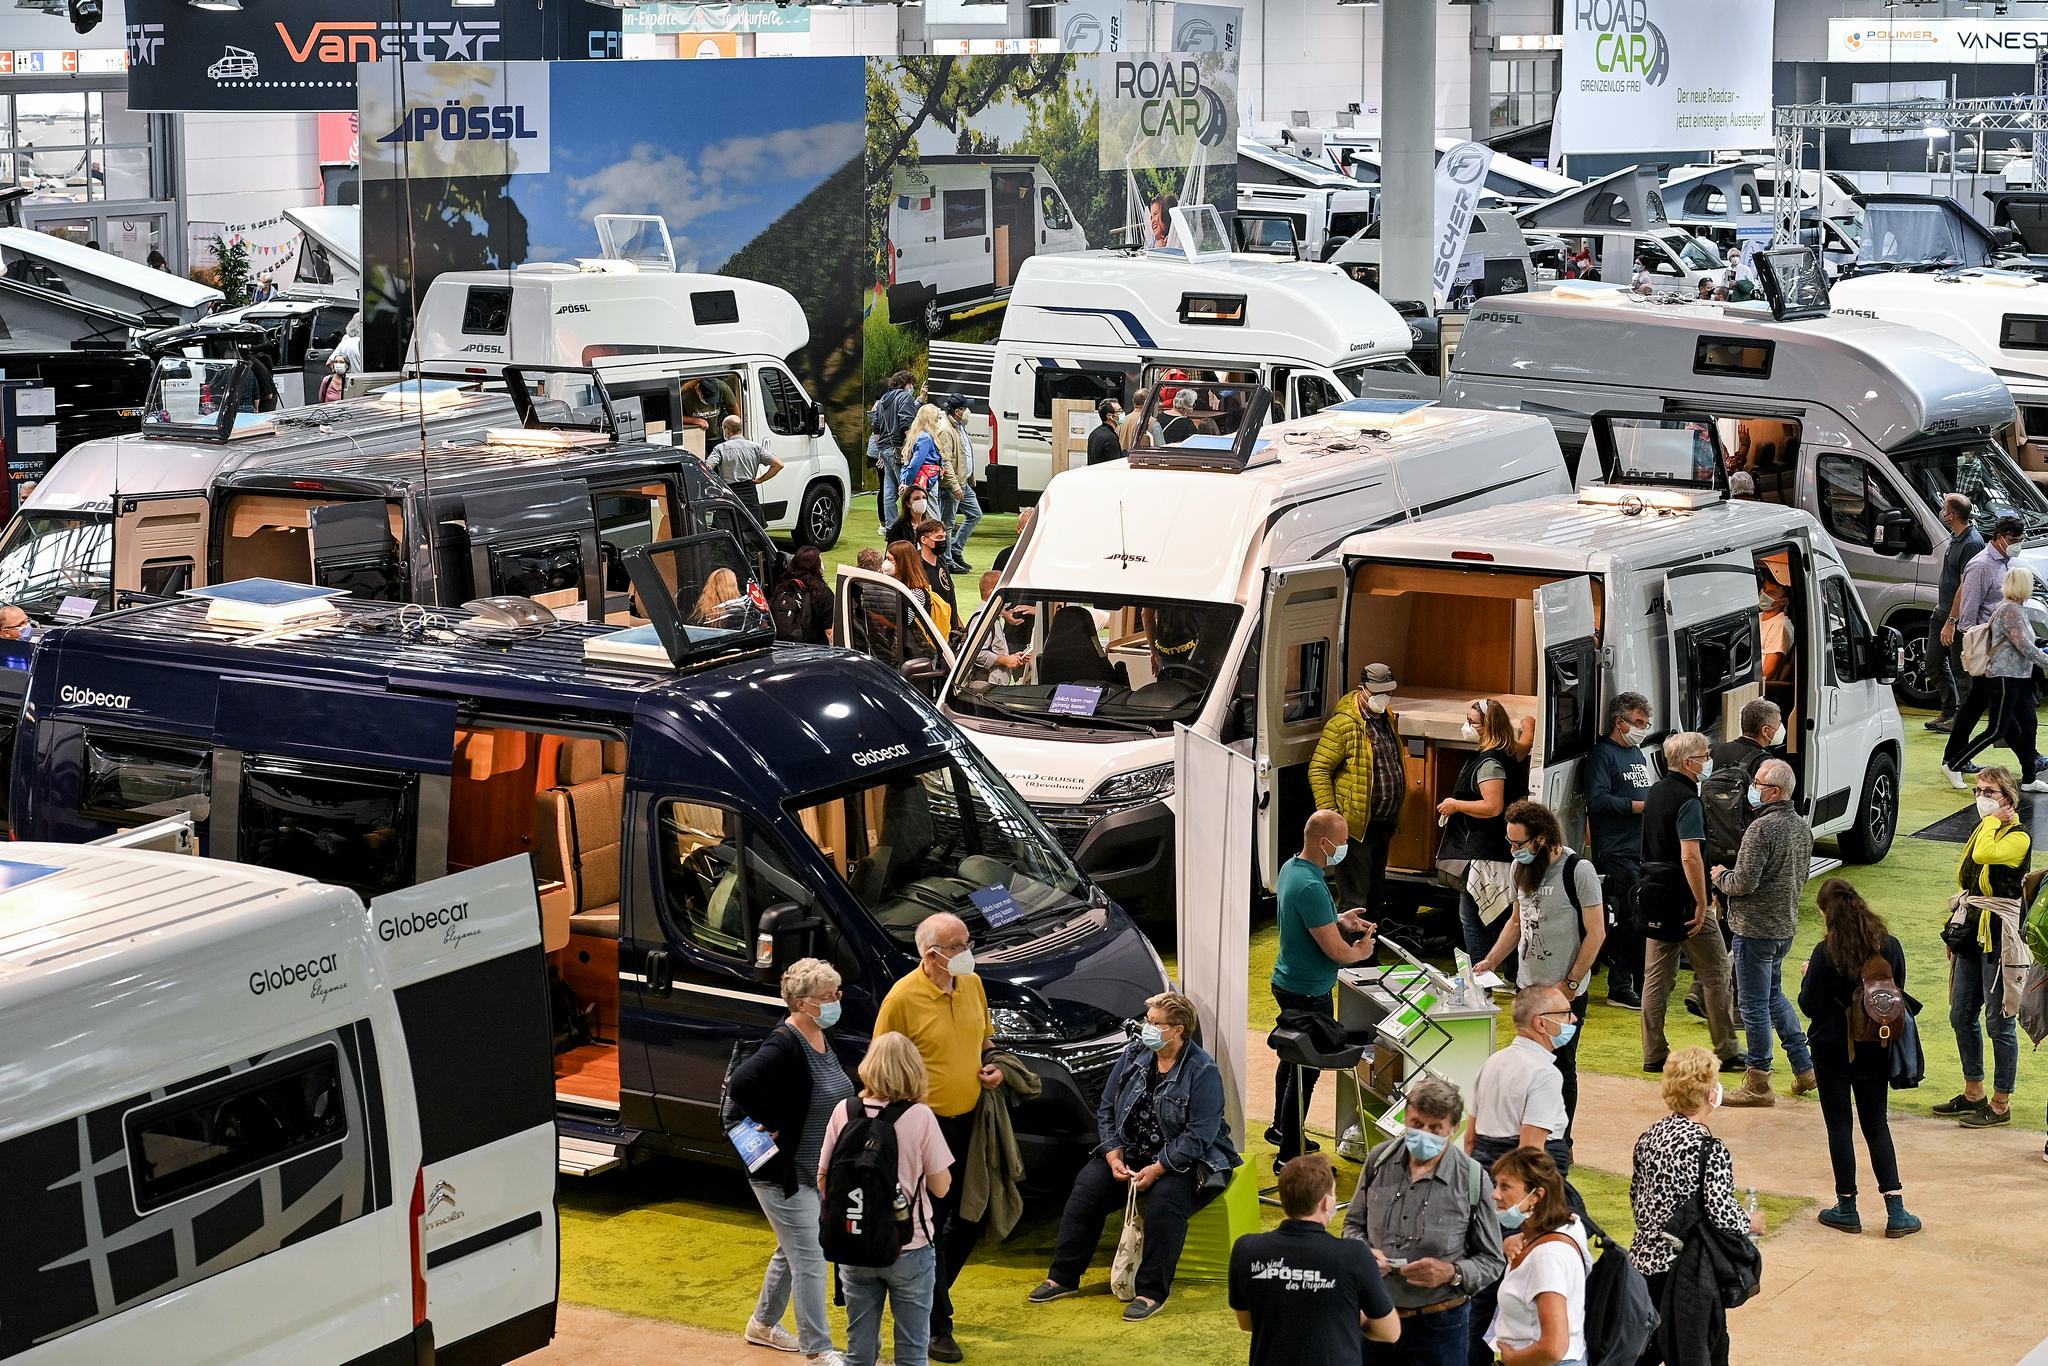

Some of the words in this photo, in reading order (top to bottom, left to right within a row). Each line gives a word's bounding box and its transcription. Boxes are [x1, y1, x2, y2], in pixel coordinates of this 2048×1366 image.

[1575, 0, 1648, 33] ROAD
[1866, 30, 1932, 39] POLIMER
[588, 30, 622, 58] CA
[1595, 33, 1652, 76] CAR
[1115, 61, 1200, 99] ROAD
[1580, 80, 1625, 92] GRENZENLOS
[1626, 81, 1641, 92] FREI
[1677, 87, 1689, 103] Der
[1690, 91, 1707, 103] neue
[1708, 87, 1735, 103] Roadcar
[414, 99, 538, 141] PÖSSL
[1140, 99, 1203, 137] CAR
[1675, 113, 1692, 132] jetzt
[562, 303, 591, 314] PÖSSL
[1481, 311, 1522, 324] PÖSSL
[469, 343, 504, 354] PÖSSL
[1350, 340, 1375, 352] Concorde
[1933, 419, 1960, 430] PÖSSL
[60, 684, 131, 709] Globecar
[852, 743, 910, 767] Globecar
[1630, 763, 1645, 772] THE
[1025, 781, 1084, 790] (R)evolution
[1040, 775, 1085, 784] CRUISER
[1632, 779, 1649, 788] FACE
[379, 902, 469, 942] Globecar
[443, 925, 482, 949] Elegance
[249, 953, 338, 995] Globecar
[311, 977, 348, 1004] Elegance
[846, 1187, 863, 1235] FILA
[1266, 1257, 1284, 1269] sind
[1267, 1266, 1327, 1281] PÖSSL
[1285, 1280, 1300, 1290] das
[1302, 1278, 1336, 1292] Original
